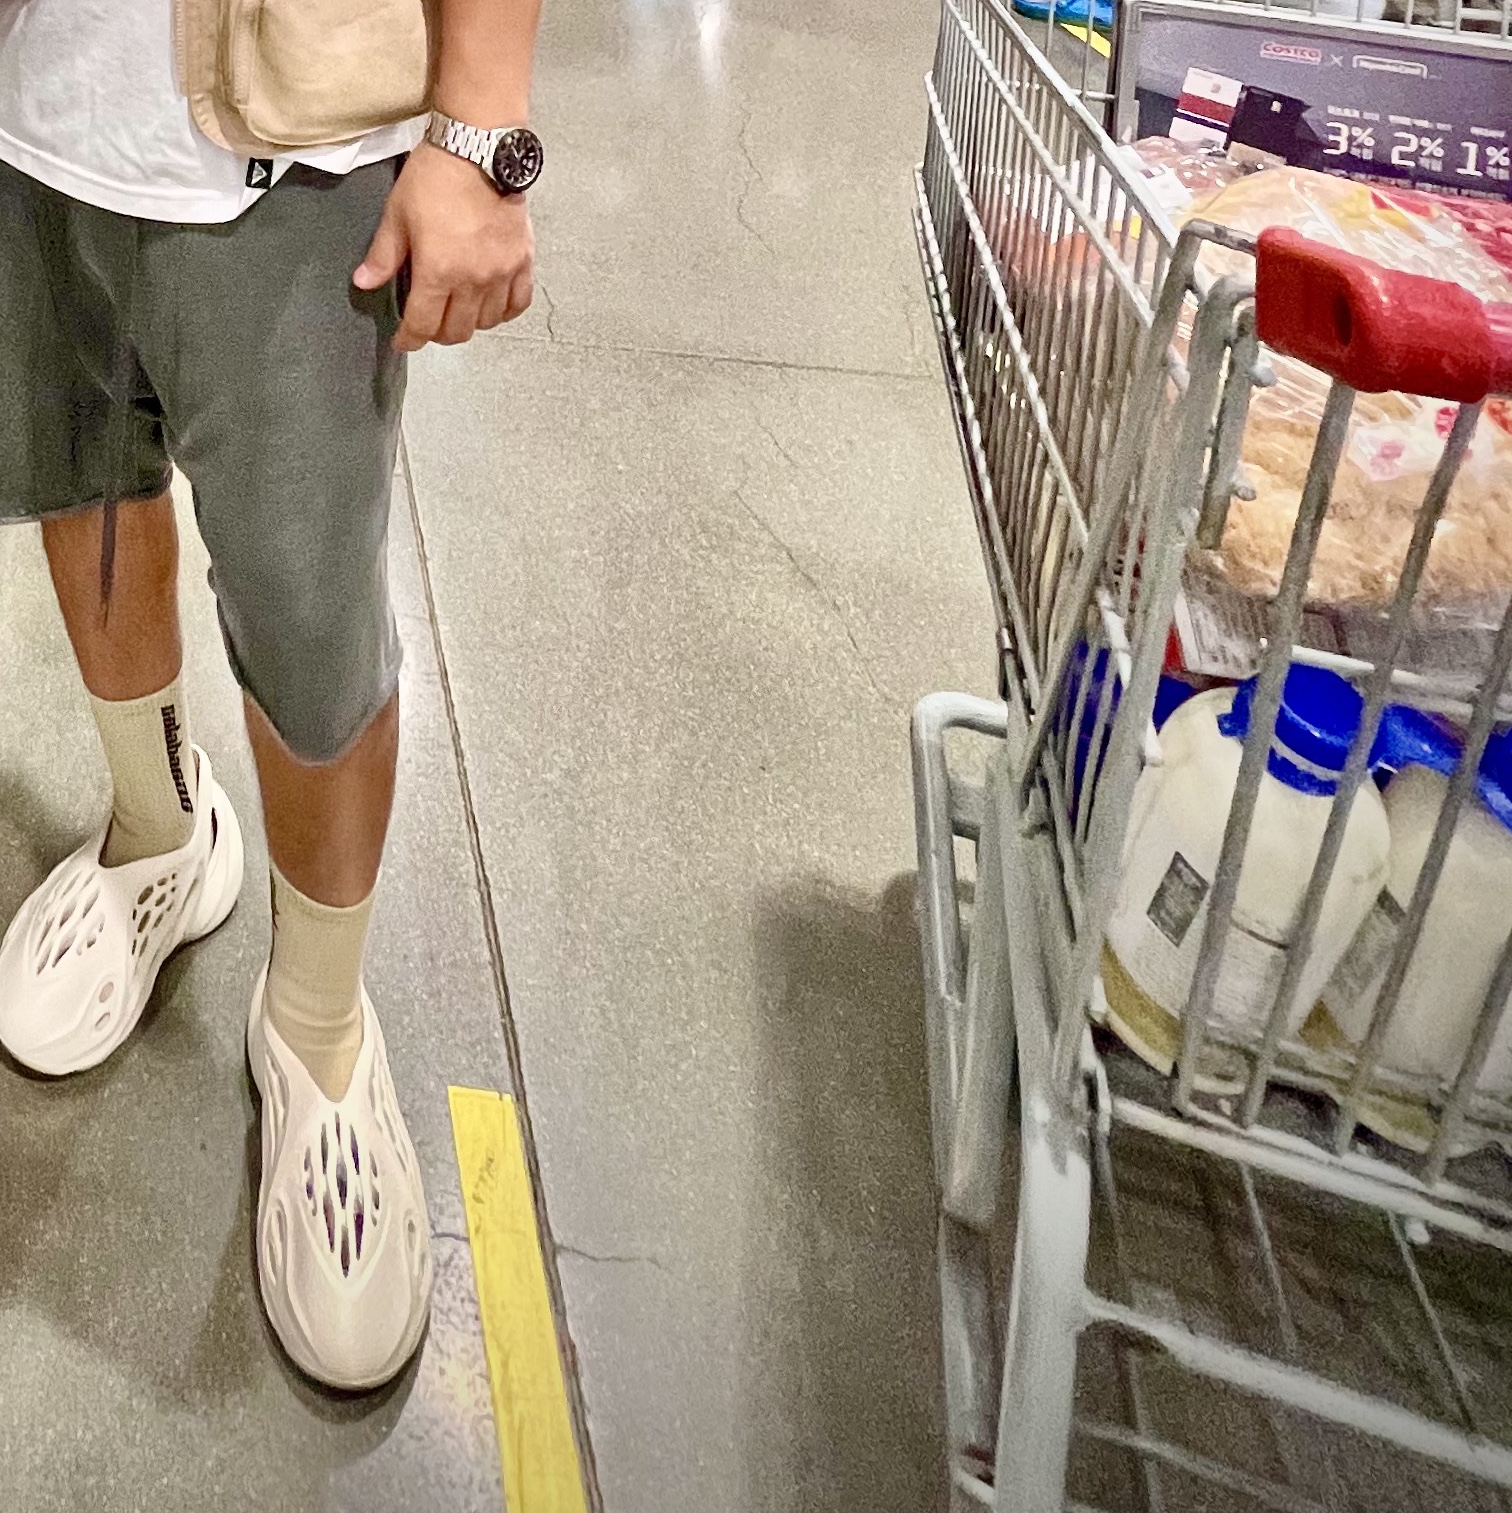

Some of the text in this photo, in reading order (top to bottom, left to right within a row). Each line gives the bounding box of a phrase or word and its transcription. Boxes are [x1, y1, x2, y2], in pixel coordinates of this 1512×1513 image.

[1263, 43, 1320, 58] COSTCO
[1323, 121, 1375, 155] 3%
[1391, 131, 1445, 167] 2%
